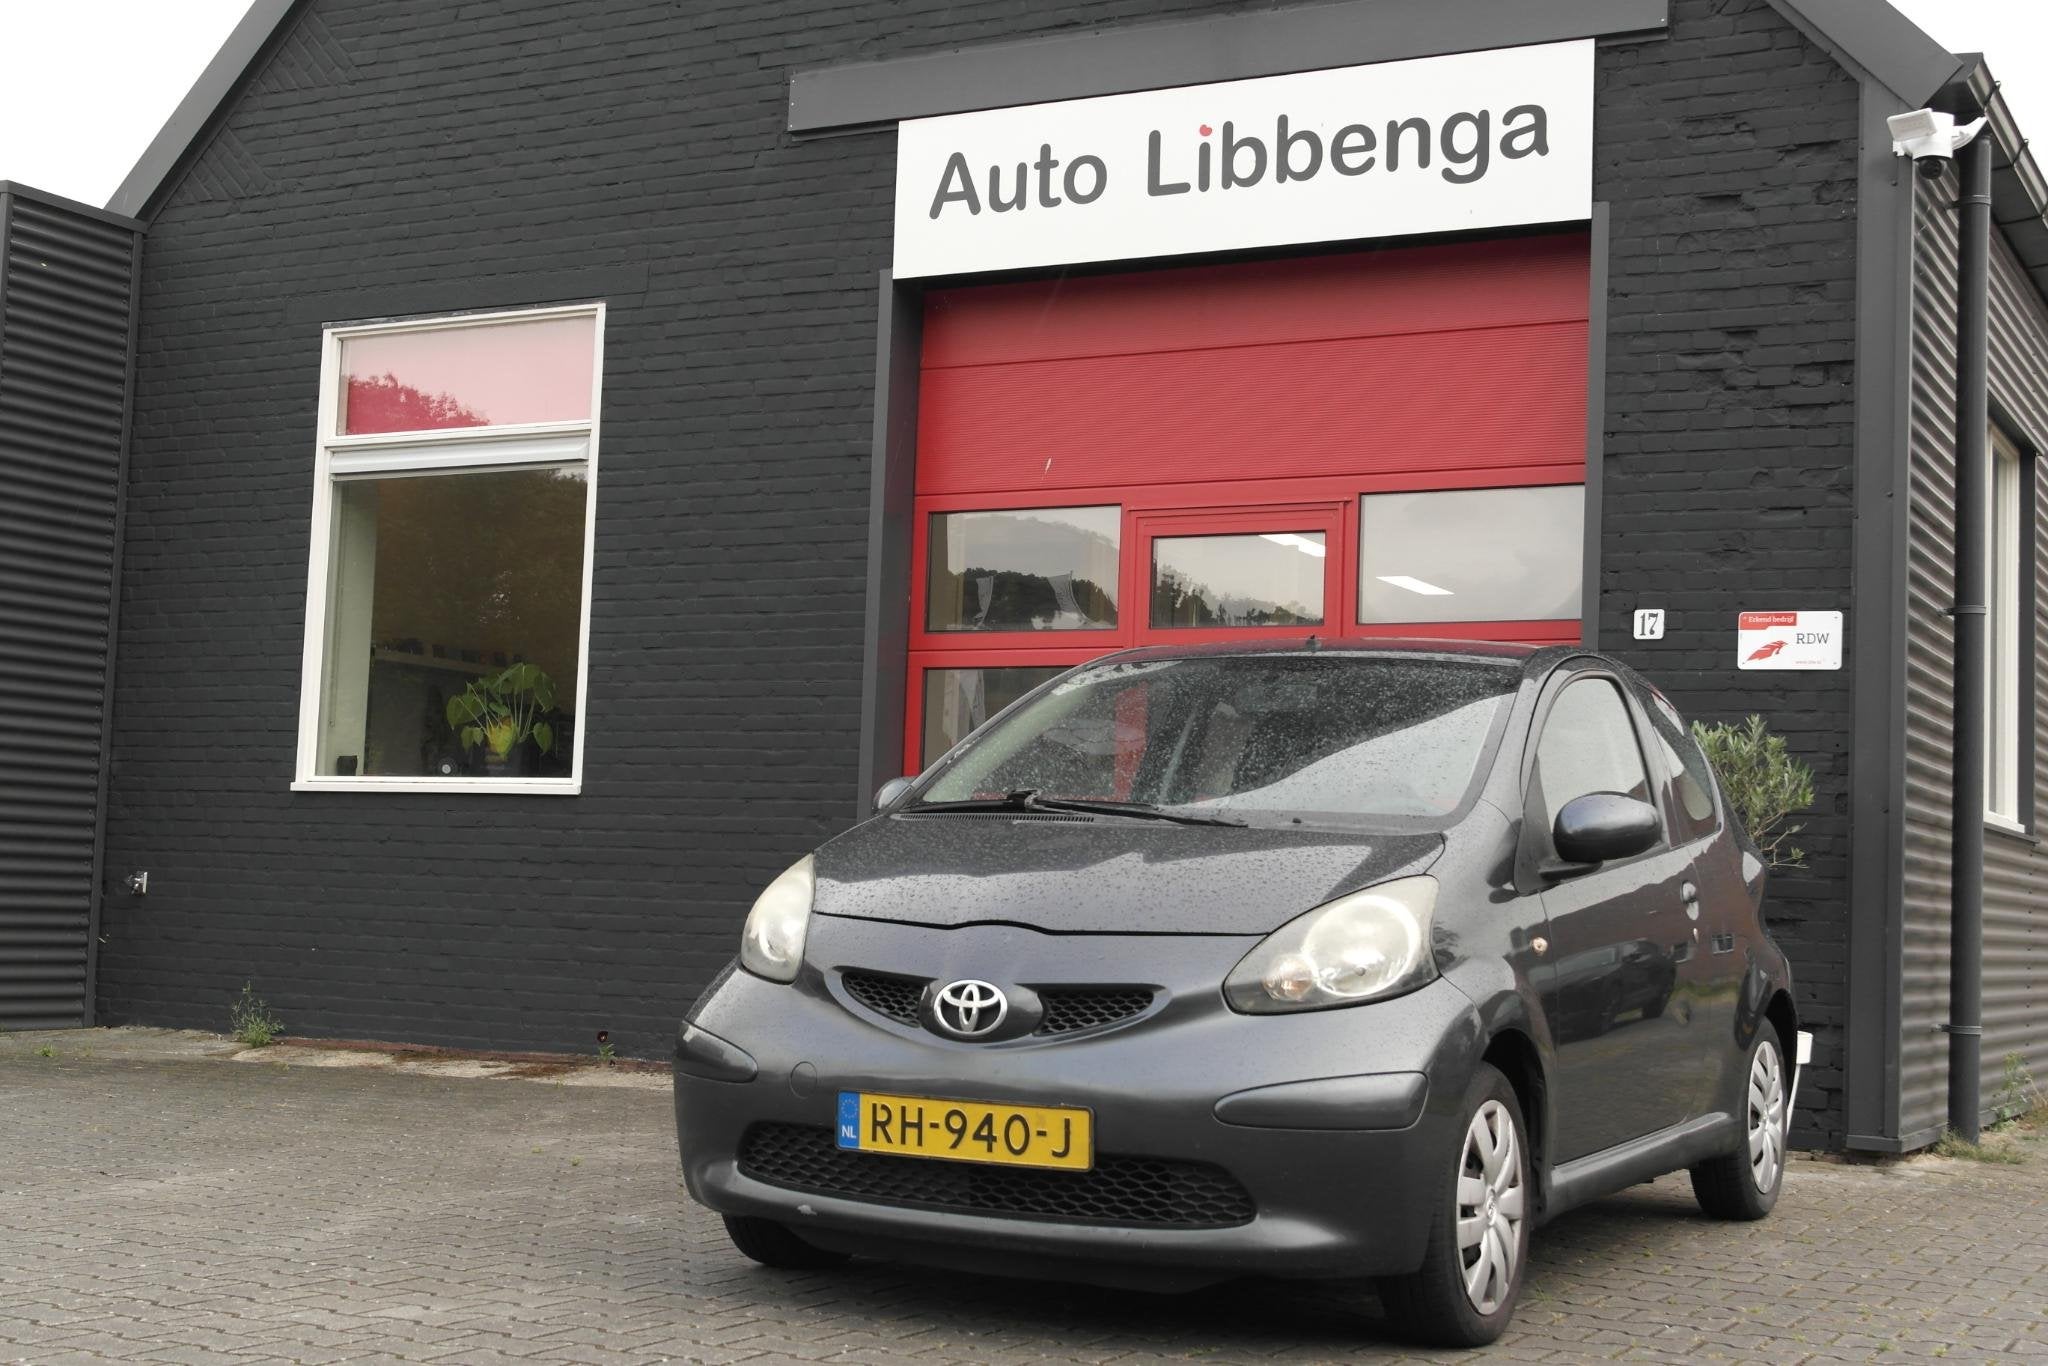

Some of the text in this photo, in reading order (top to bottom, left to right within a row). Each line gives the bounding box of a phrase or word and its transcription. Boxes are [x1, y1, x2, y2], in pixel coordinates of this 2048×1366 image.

[928, 103, 1551, 220] Auto Libbenga
[1638, 612, 1659, 636] 17
[1796, 632, 1830, 645] RDW
[841, 1125, 857, 1140] NL
[870, 1102, 1072, 1158] RH-940-J
